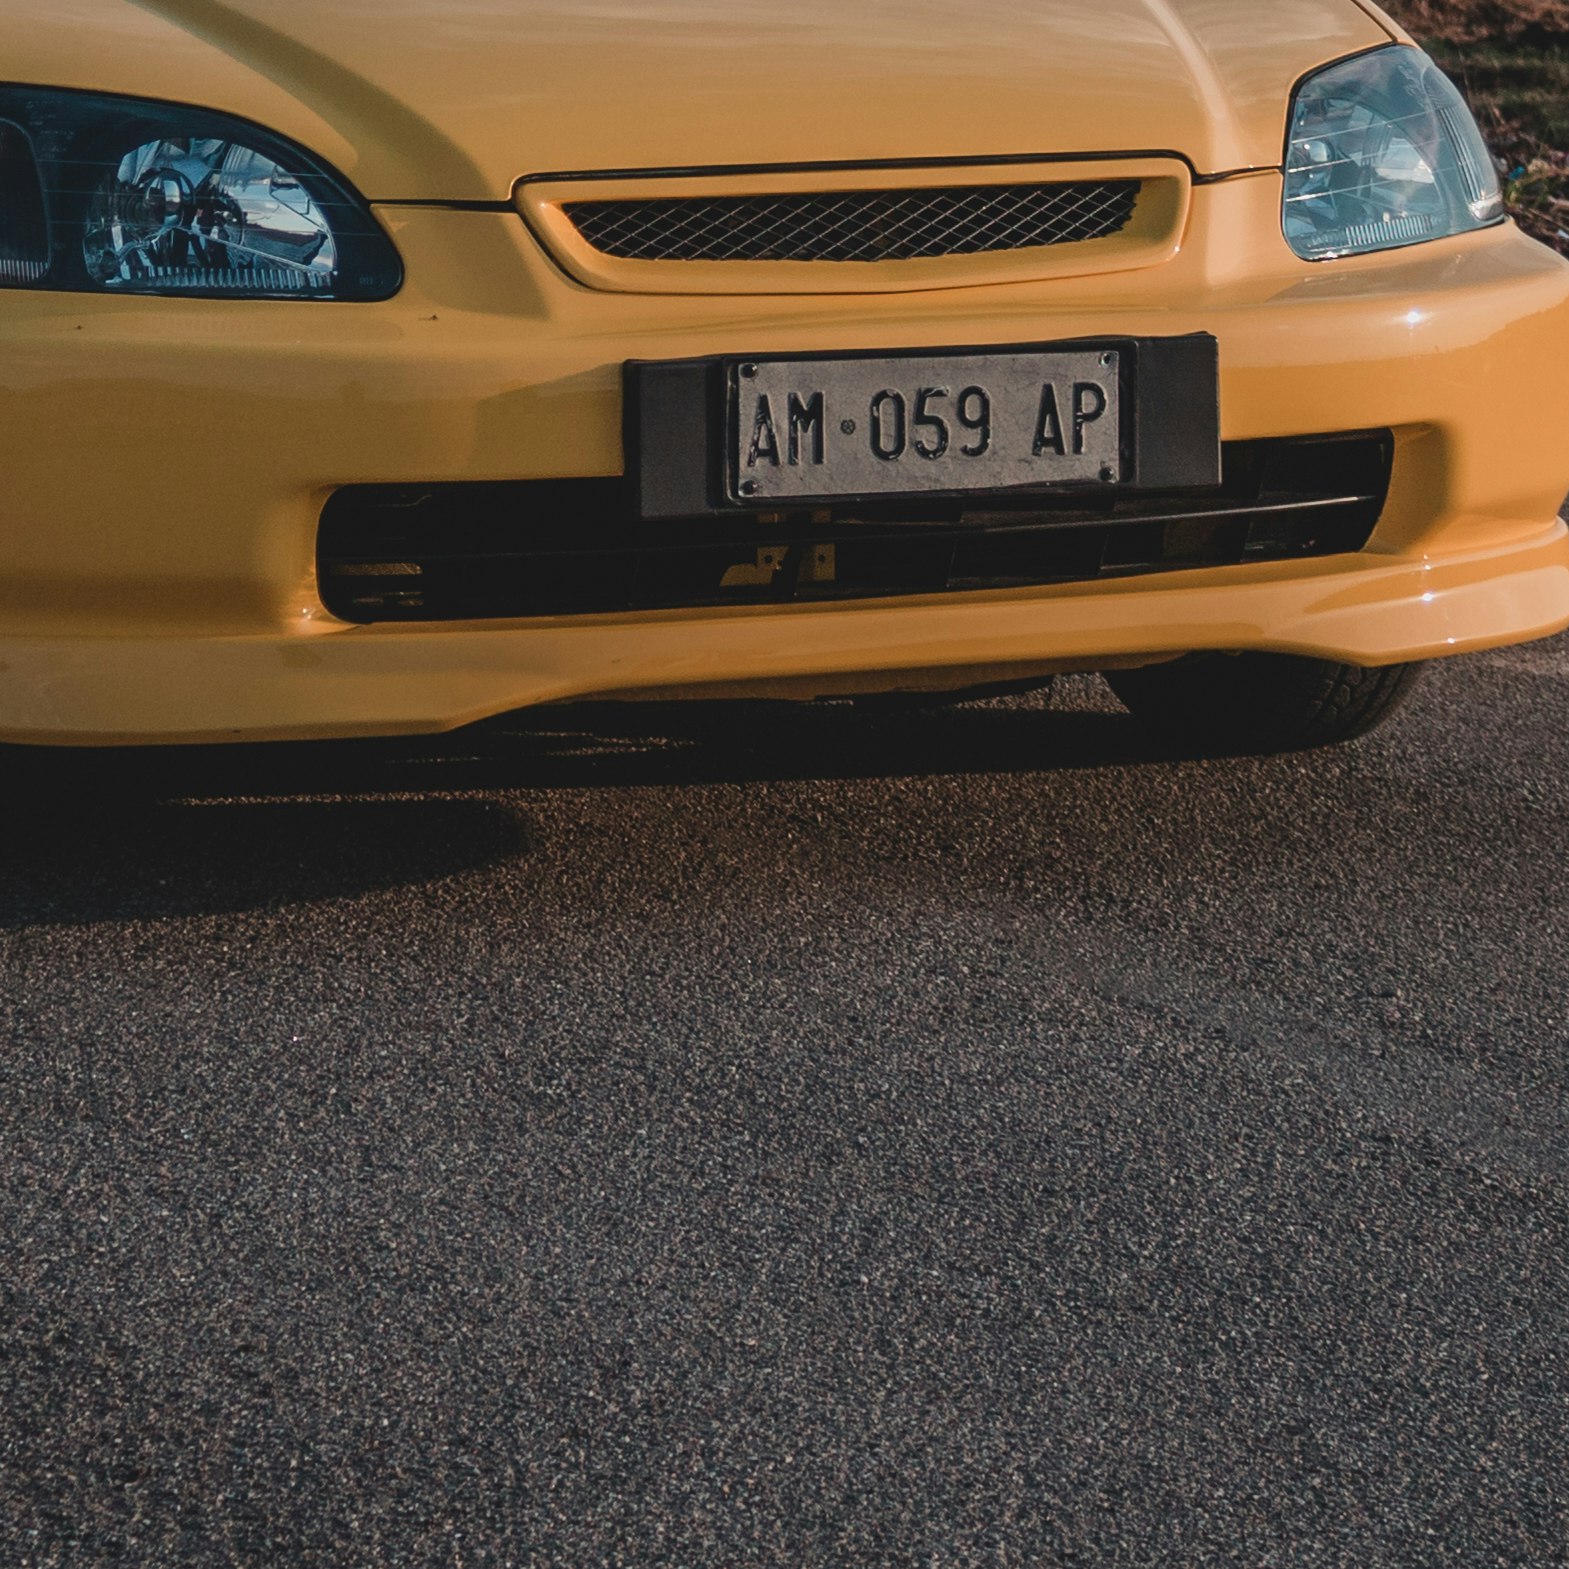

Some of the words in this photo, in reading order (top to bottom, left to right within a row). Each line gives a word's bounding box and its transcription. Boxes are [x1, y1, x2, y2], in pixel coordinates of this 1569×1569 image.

[746, 391, 825, 468] AM
[870, 385, 991, 461] 059
[1032, 381, 1108, 457] AP
